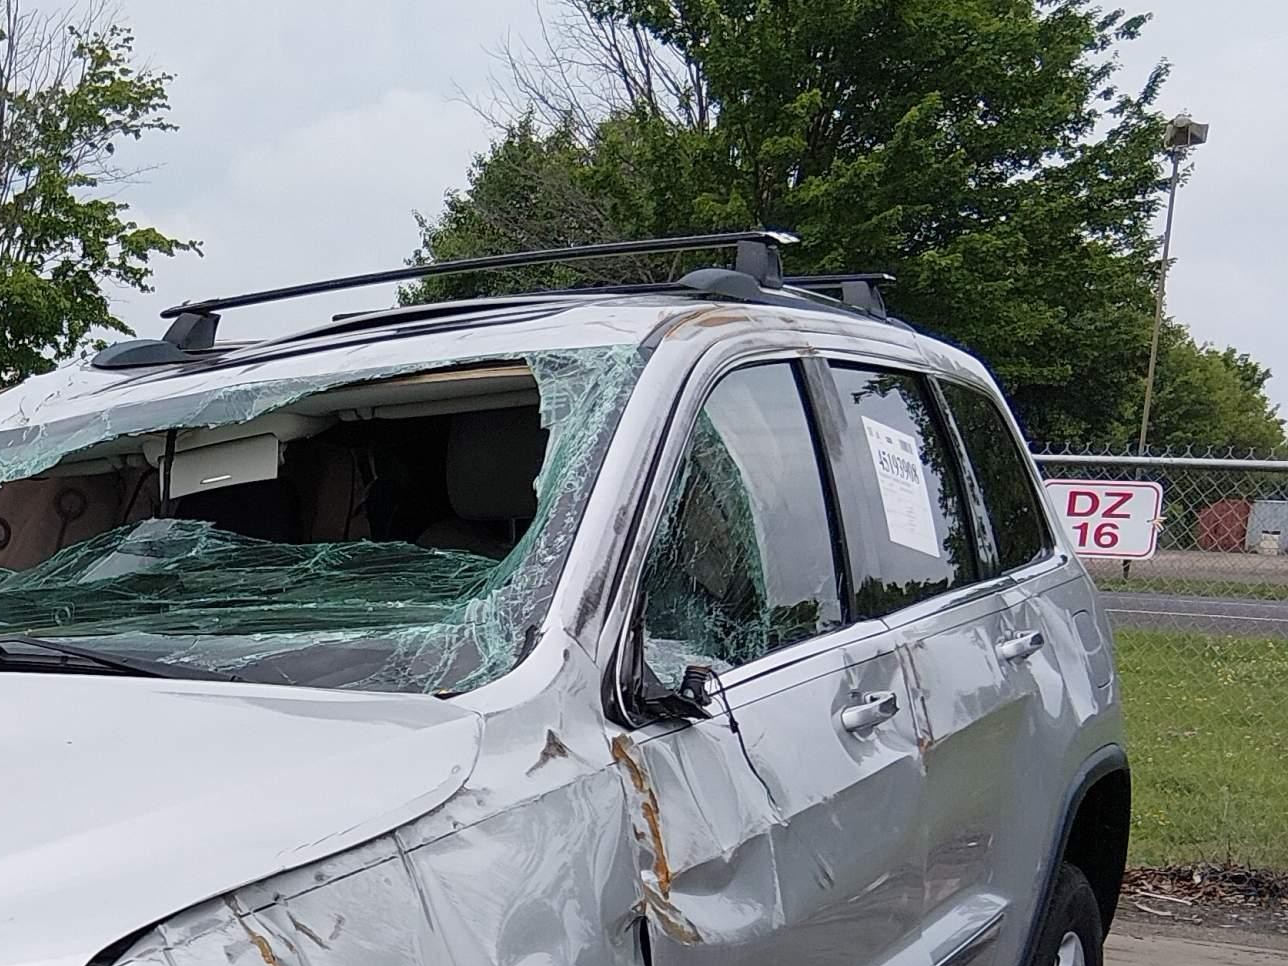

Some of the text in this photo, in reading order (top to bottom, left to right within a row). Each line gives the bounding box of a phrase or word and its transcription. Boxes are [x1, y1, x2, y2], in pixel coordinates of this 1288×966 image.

[877, 448, 920, 485] 45193908
[1066, 490, 1134, 519] DZ
[1072, 522, 1120, 549] 16
